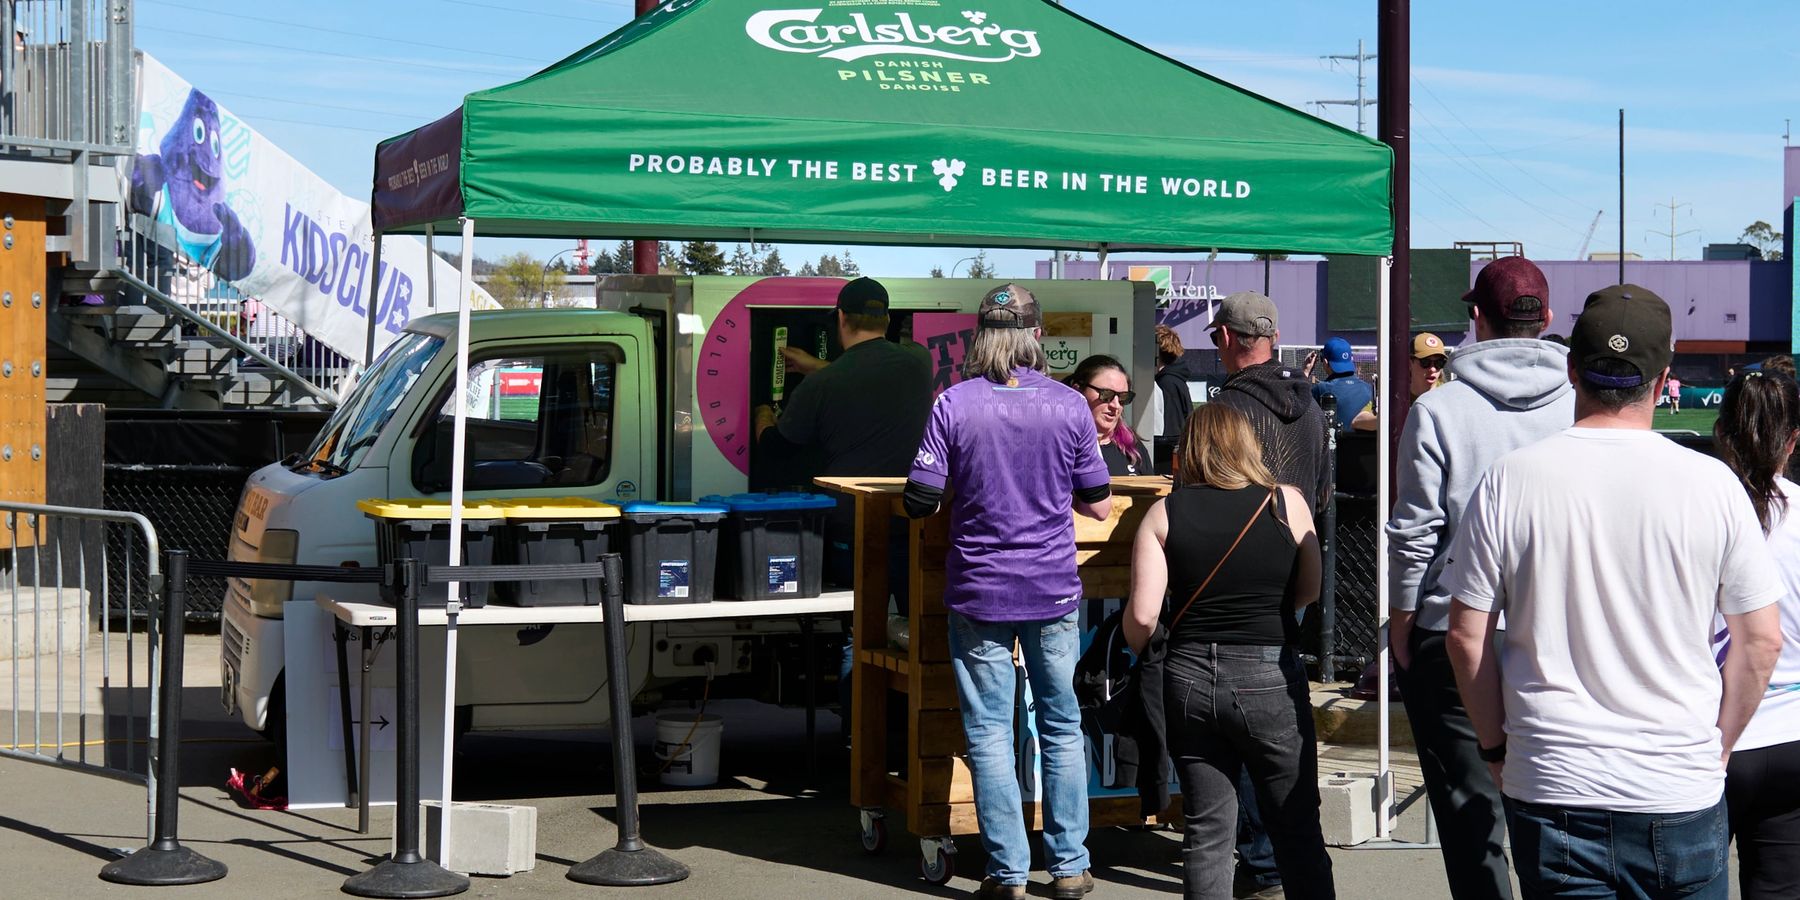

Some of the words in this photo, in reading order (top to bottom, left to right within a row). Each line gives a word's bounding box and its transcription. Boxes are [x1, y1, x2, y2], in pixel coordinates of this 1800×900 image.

[745, 8, 1042, 61] Carlsberg
[874, 60, 943, 68] DANISH
[838, 70, 991, 84] PILSNER
[879, 83, 961, 92] DANOISE
[628, 154, 777, 177] PROBABLY
[788, 159, 838, 179] THE
[852, 162, 917, 182] BEST
[982, 168, 1048, 189] BEER
[1062, 172, 1087, 191] IN
[1100, 174, 1148, 194] THE
[1161, 177, 1251, 199] WORLD
[1162, 282, 1217, 298] Arena
[707, 318, 736, 377] COLD
[1041, 343, 1079, 369] berg
